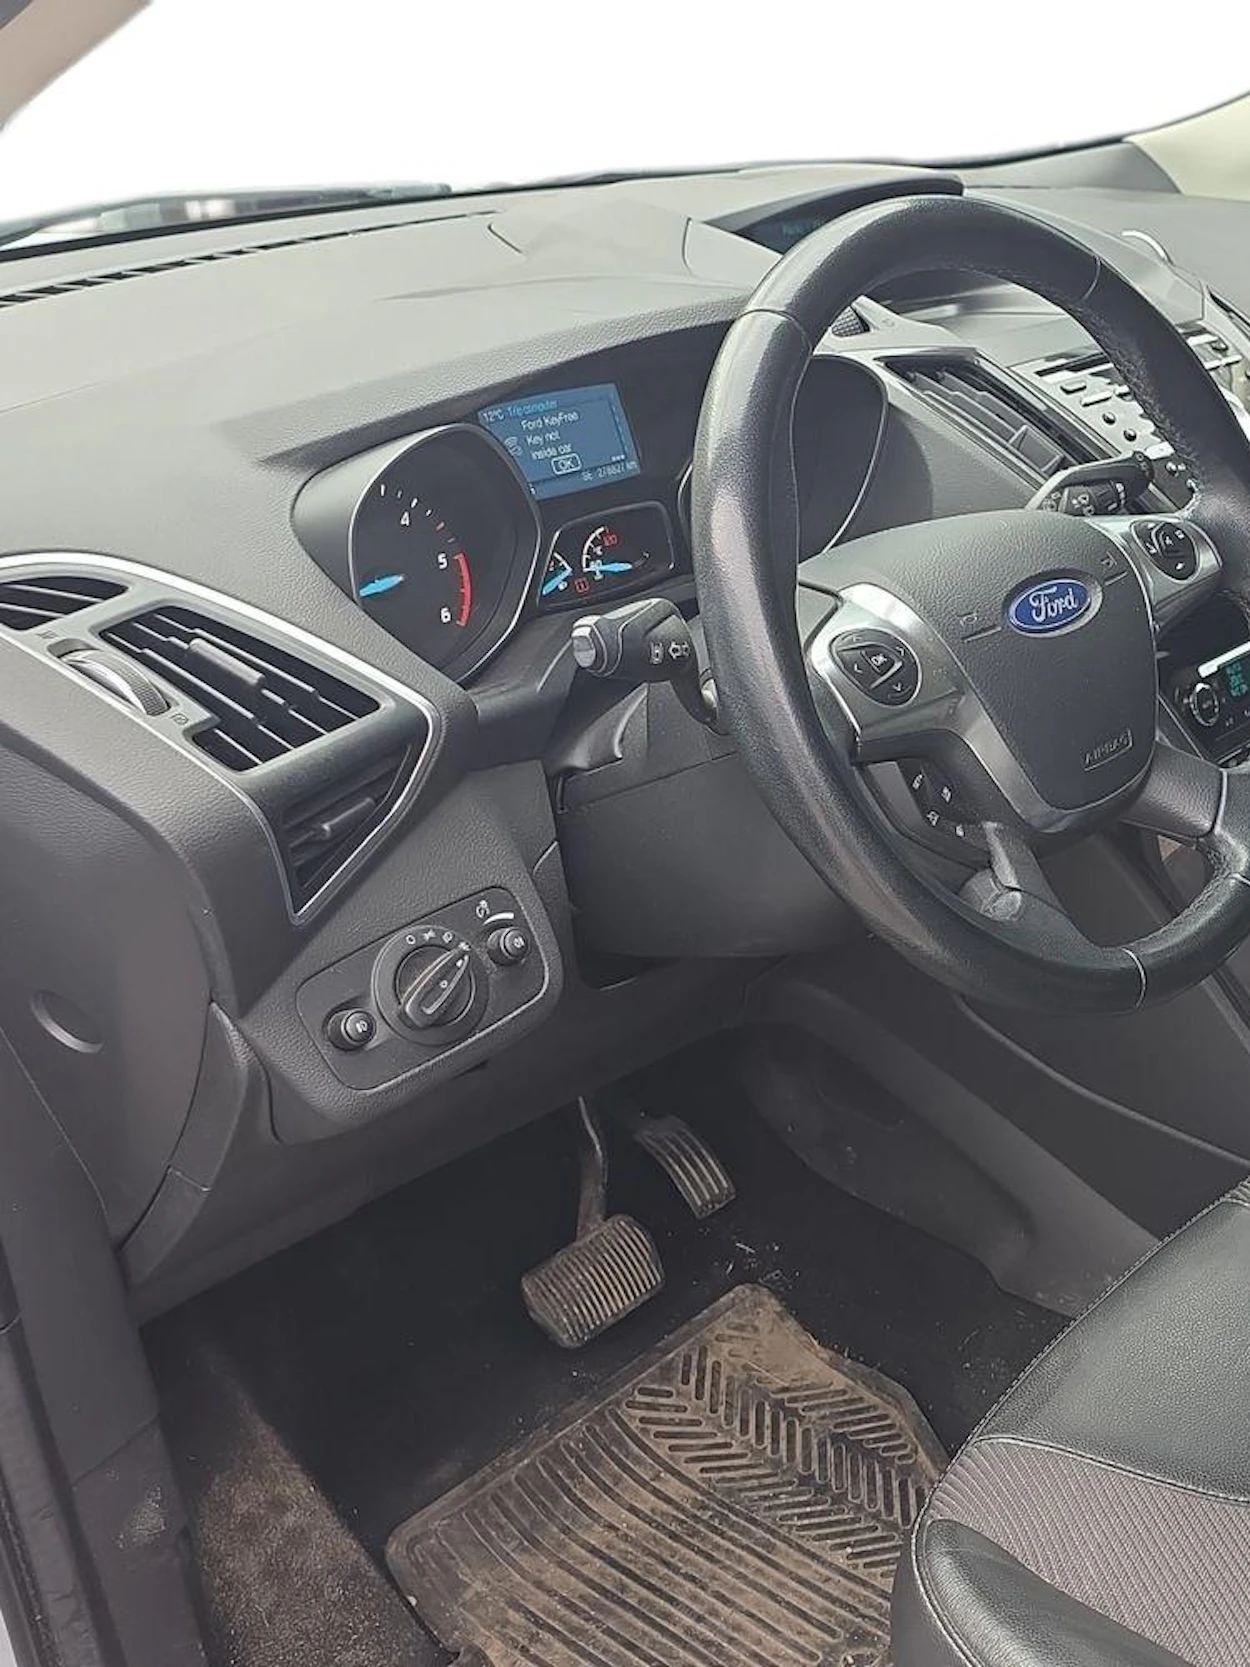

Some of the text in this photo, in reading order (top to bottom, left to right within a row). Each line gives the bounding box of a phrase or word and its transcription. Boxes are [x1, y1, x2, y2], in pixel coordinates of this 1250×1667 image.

[521, 418, 542, 430] Ford
[526, 430, 560, 447] Key not
[558, 443, 572, 455] car
[558, 458, 575, 471] OK
[400, 511, 410, 527] 4
[437, 553, 448, 570] 5
[1028, 586, 1079, 623] Ford
[440, 607, 451, 624] 6
